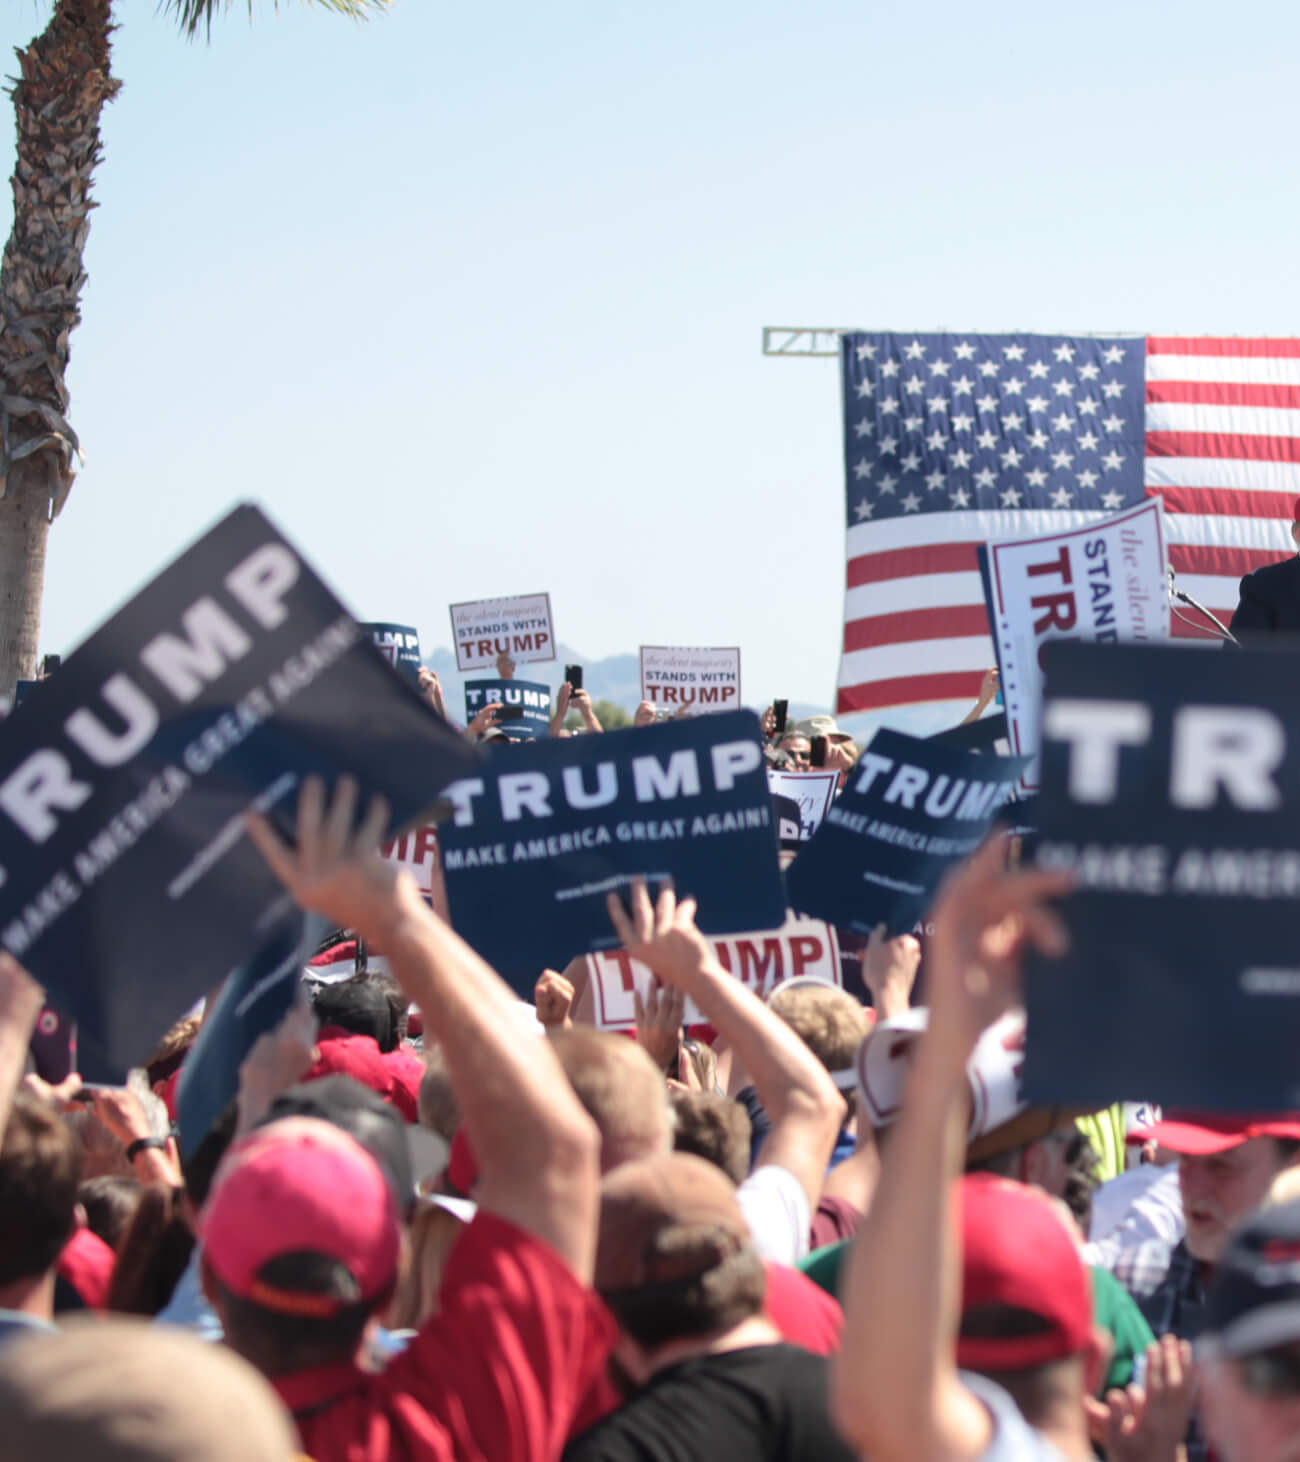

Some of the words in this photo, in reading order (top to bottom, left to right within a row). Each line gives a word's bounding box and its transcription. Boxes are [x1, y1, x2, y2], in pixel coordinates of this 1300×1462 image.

[1084, 539, 1119, 645] STAND
[458, 621, 510, 638] STANDS
[512, 618, 547, 631] WITH
[460, 633, 549, 659] TRUMP
[0, 541, 301, 846] RUMP
[466, 688, 550, 709] TRUMP
[645, 671, 697, 681] STANDS
[701, 672, 736, 681] WITH
[646, 685, 736, 705] TRUMP
[440, 739, 762, 828] TRUMP
[73, 763, 191, 887] AMERICA
[444, 841, 507, 870] MAKE
[512, 823, 611, 863] AMERICA
[616, 818, 686, 843] GREAT
[691, 805, 771, 837] AGAIN!
